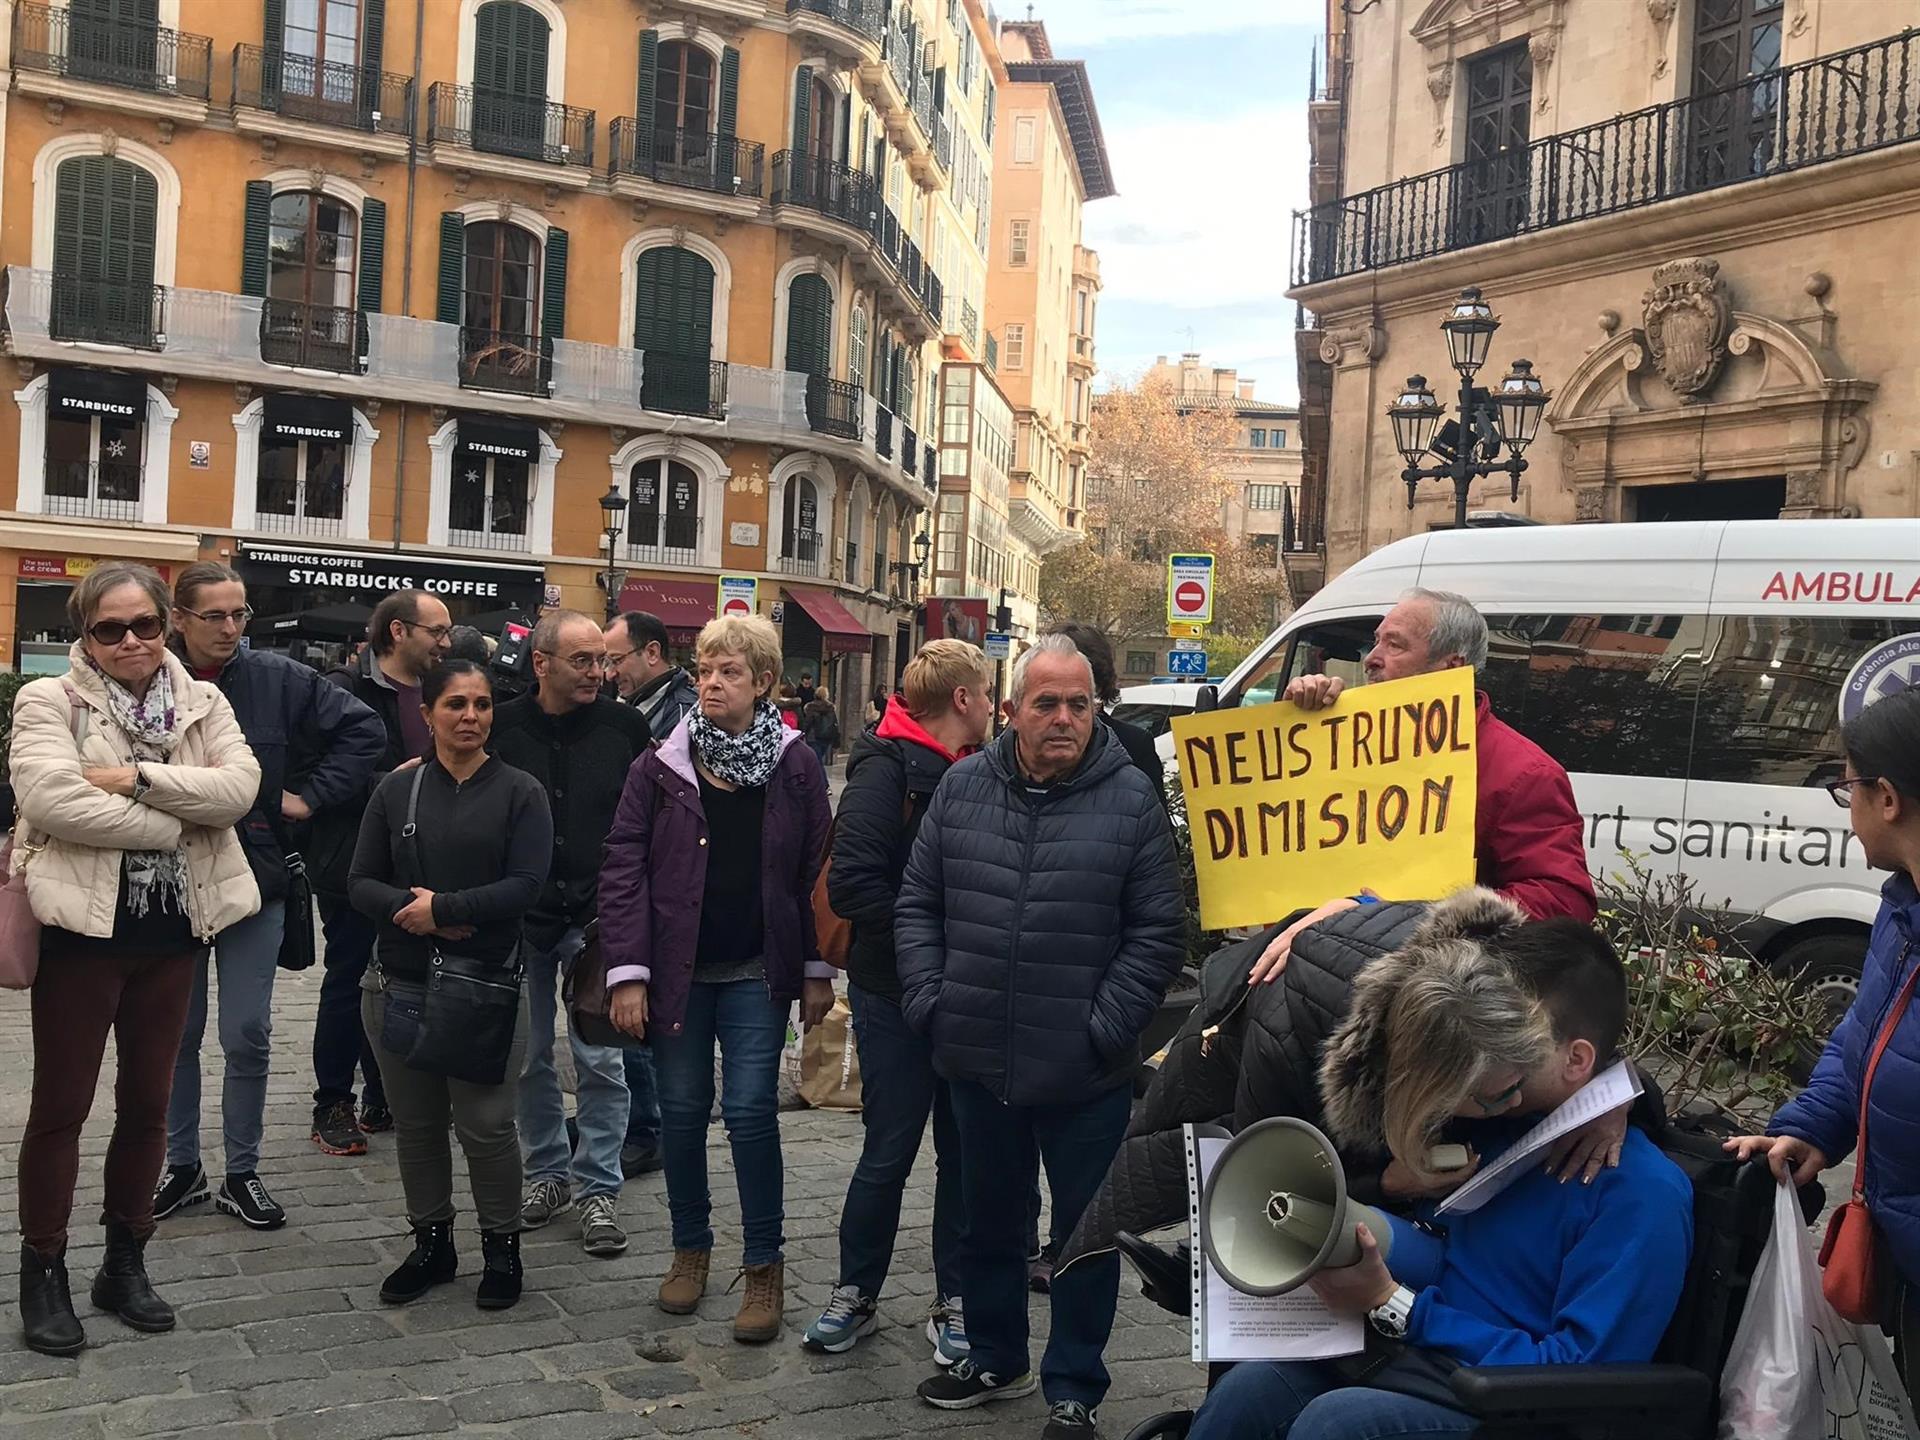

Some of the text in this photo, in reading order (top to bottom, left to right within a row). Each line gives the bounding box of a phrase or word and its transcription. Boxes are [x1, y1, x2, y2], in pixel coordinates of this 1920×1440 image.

[62, 397, 134, 415] STARBUCKS
[276, 424, 341, 438] STARBUCKS
[468, 442, 528, 458] STARBUCKS
[250, 551, 364, 568] STARBUCKS COFFEE
[289, 569, 498, 597] STARBUCKS COFFEE
[661, 594, 700, 606] Joan
[1184, 694, 1471, 789] NEUS TRUYOL
[1203, 775, 1454, 861] DIMISION
